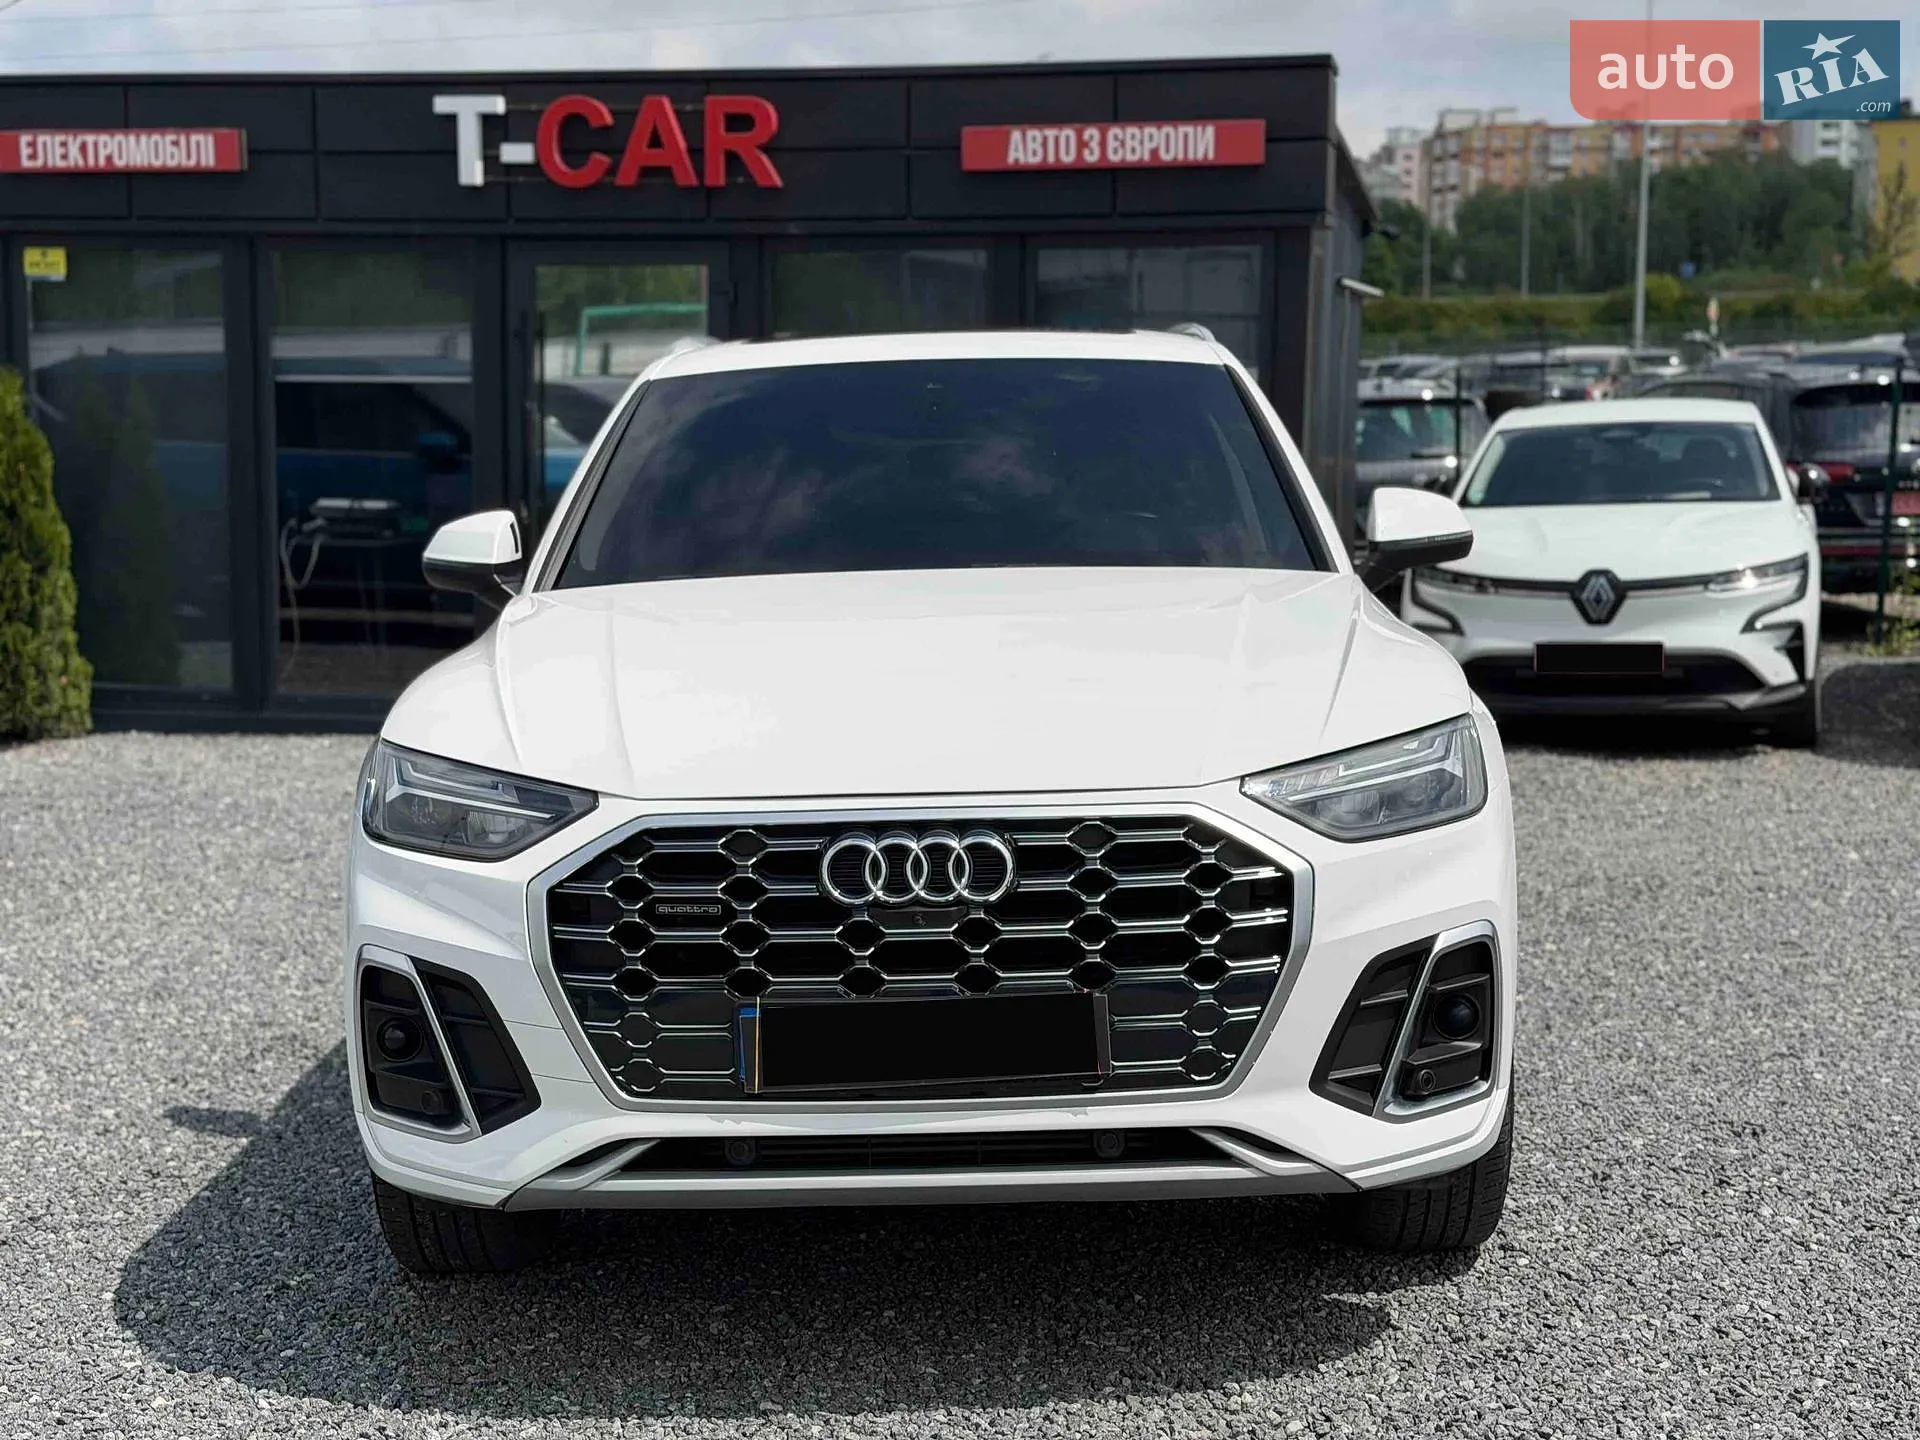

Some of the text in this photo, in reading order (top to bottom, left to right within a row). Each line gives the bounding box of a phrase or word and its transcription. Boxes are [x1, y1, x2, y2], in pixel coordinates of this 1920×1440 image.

[19, 132, 216, 168] ЕЛЕКТРОМОБІЛІ
[433, 94, 784, 188] T-CAR
[1007, 128, 1078, 164] АВТО
[1106, 124, 1217, 162] ЄВРОПИ
[658, 906, 718, 914] quattro
